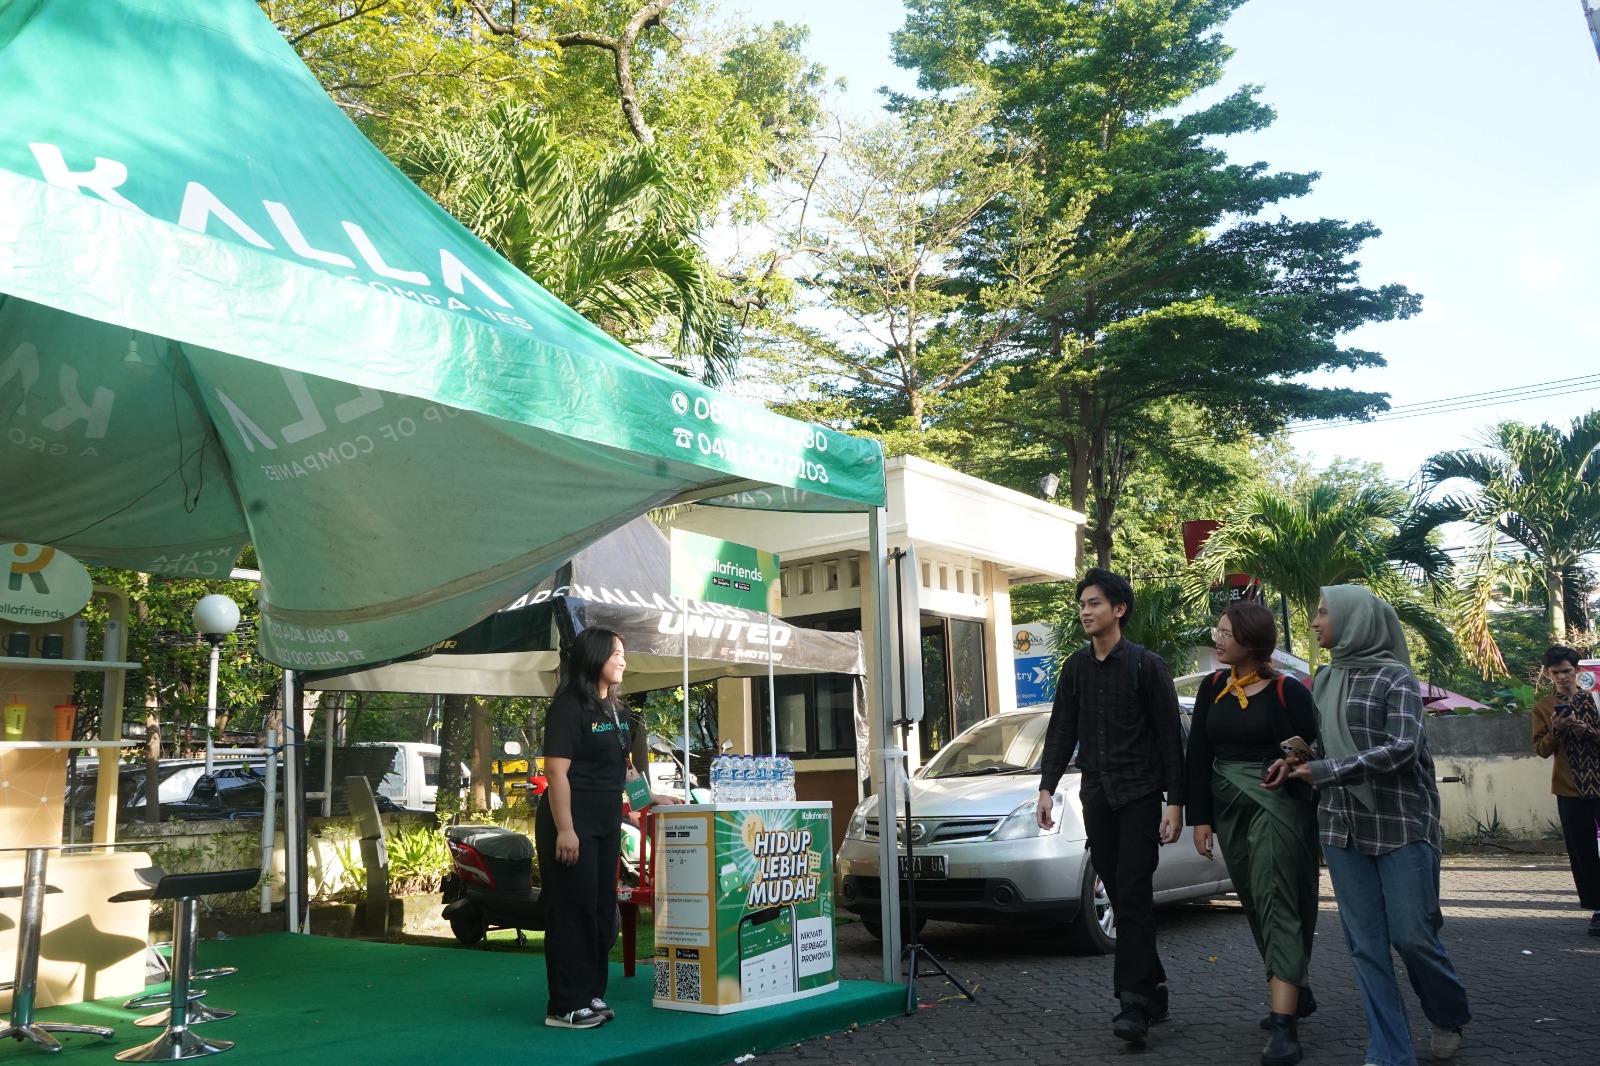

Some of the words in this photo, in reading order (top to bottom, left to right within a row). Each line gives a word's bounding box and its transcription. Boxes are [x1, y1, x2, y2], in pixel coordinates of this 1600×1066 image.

[28, 142, 515, 308] KALLA
[345, 276, 533, 331] OMPAIES
[698, 432, 740, 463] 0411
[741, 444, 783, 474] 300
[786, 455, 829, 484] 0103
[702, 558, 763, 582] allafriends
[574, 583, 677, 613] KALLA
[658, 612, 791, 647] UNITED
[1017, 672, 1032, 681] try
[755, 831, 811, 856] HIDUP
[760, 853, 808, 879] LEBIH
[748, 876, 817, 906] MUDAH
[801, 929, 823, 940] NIKMATI
